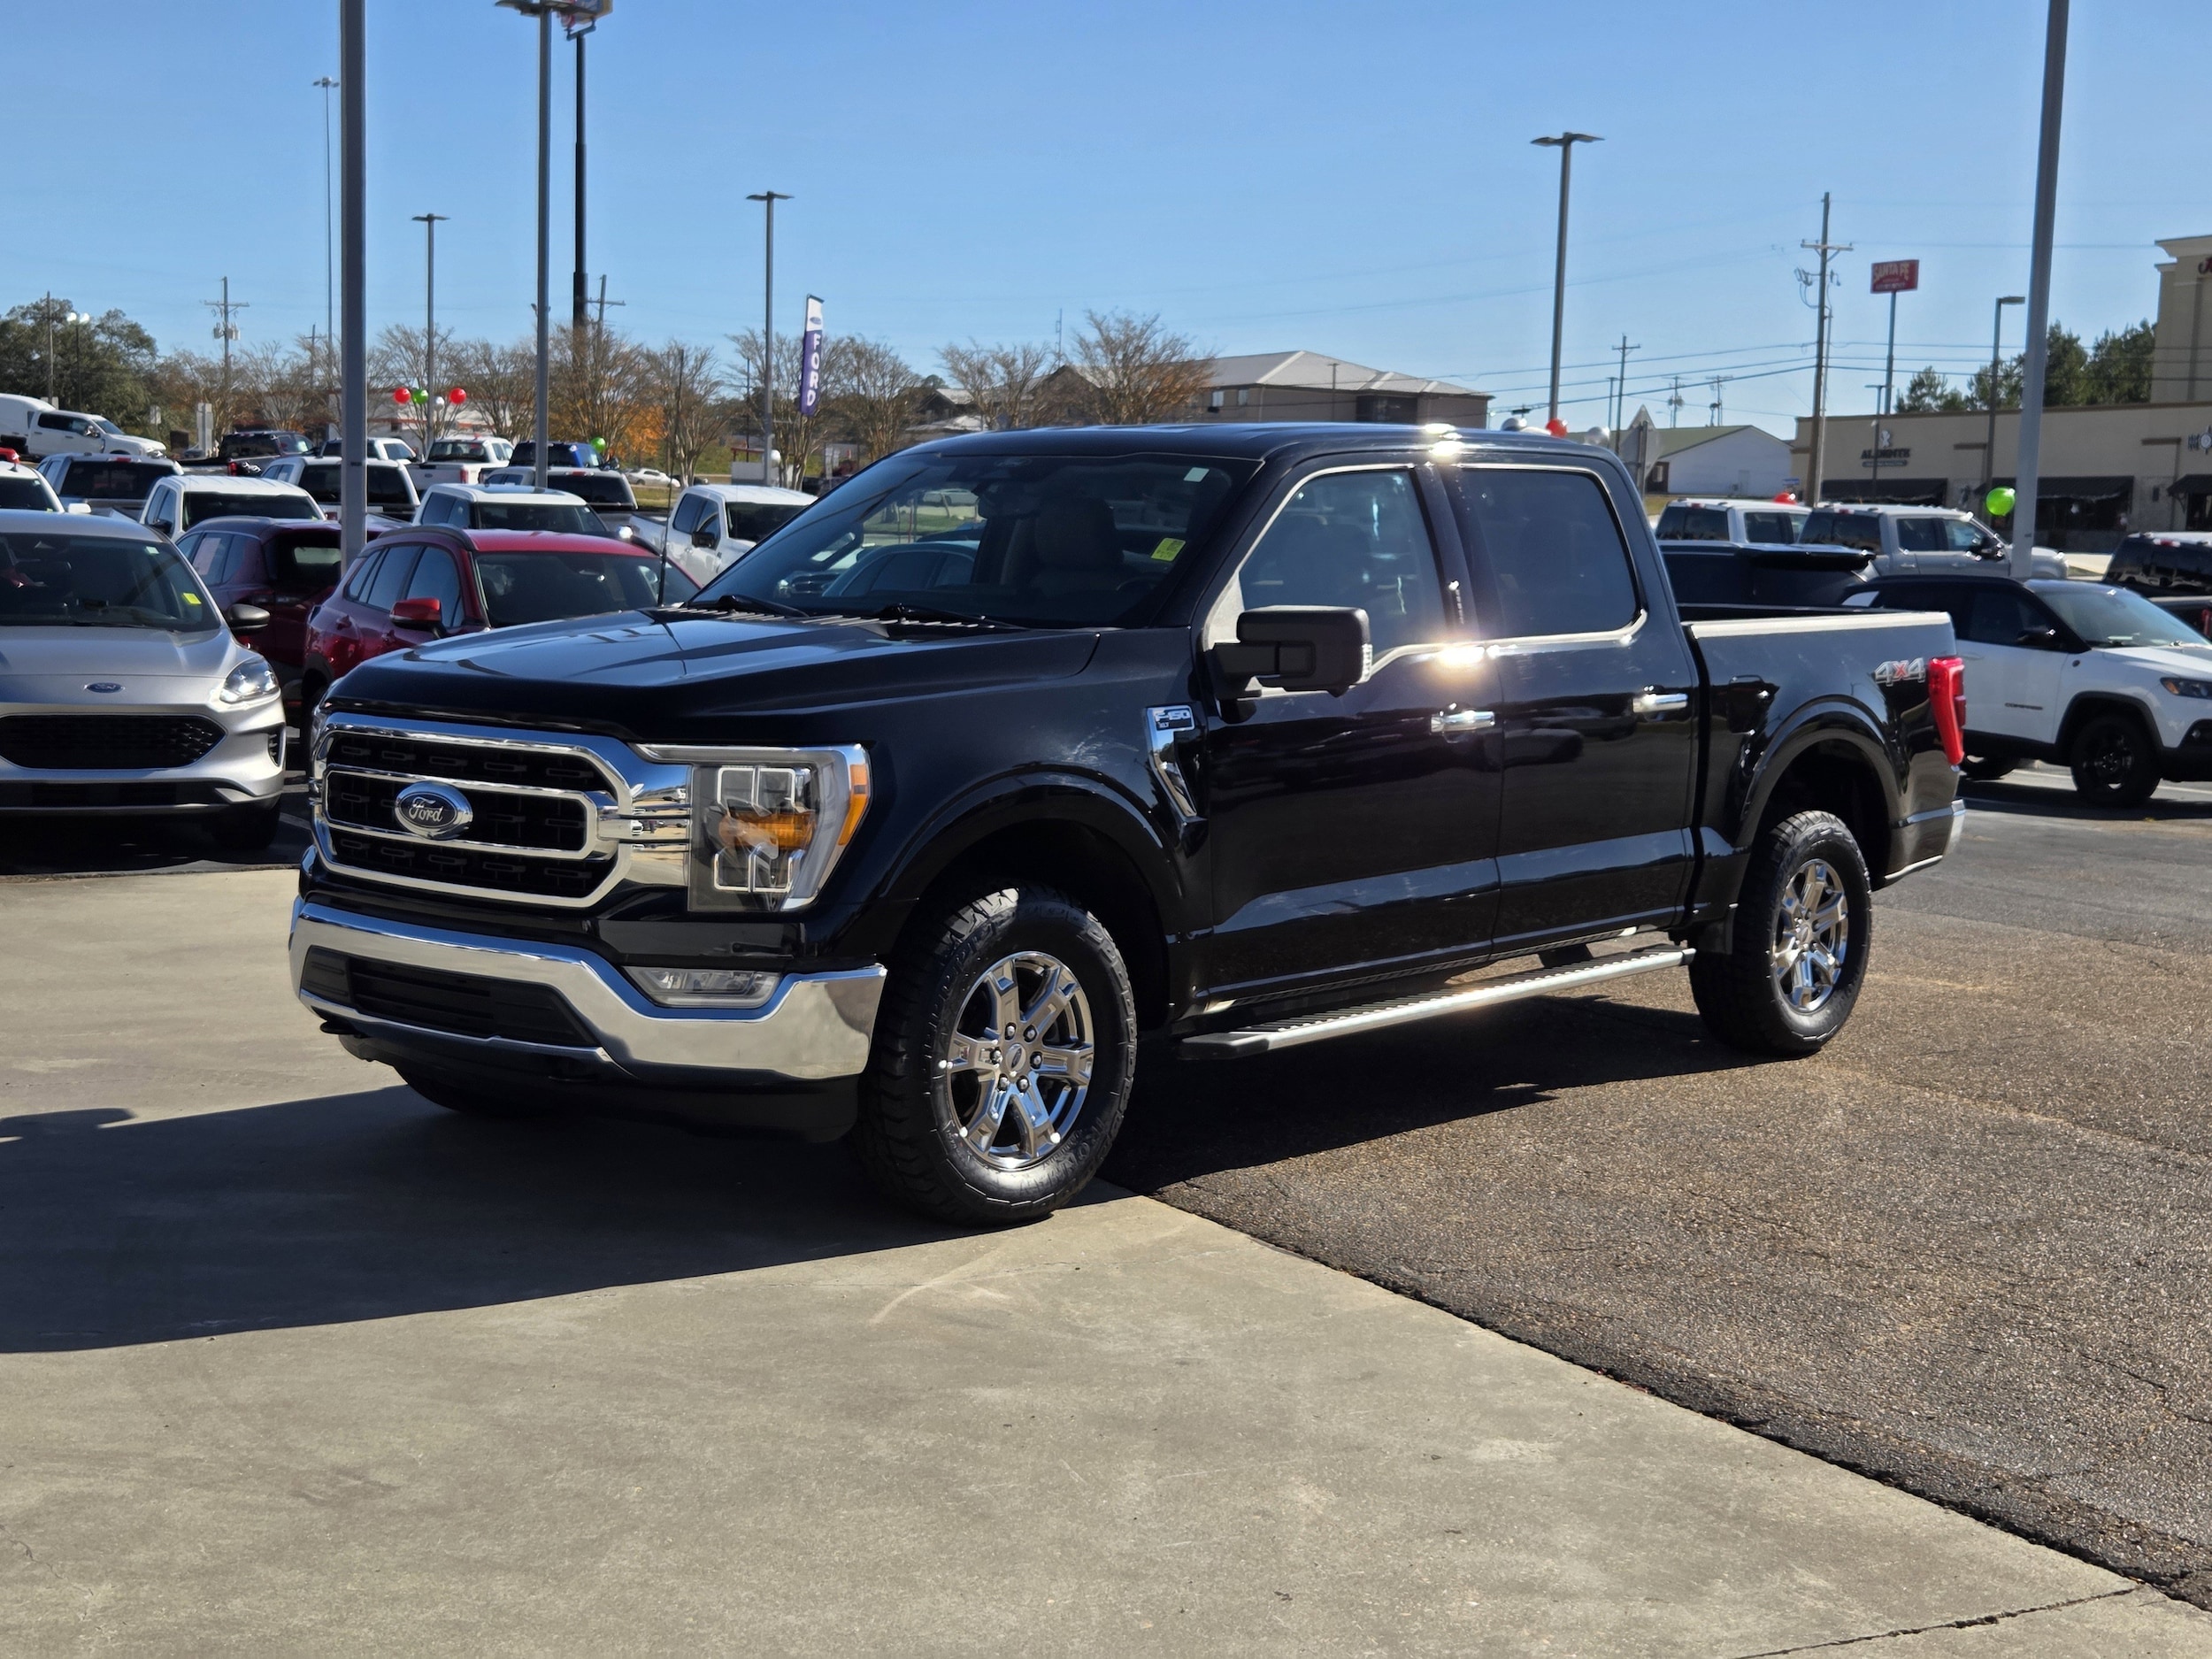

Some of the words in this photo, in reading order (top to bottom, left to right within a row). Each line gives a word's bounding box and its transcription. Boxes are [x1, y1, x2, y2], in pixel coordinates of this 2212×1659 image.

[806, 333, 821, 407] FORD
[1153, 709, 1191, 722] F-150
[409, 796, 444, 822] Ford
